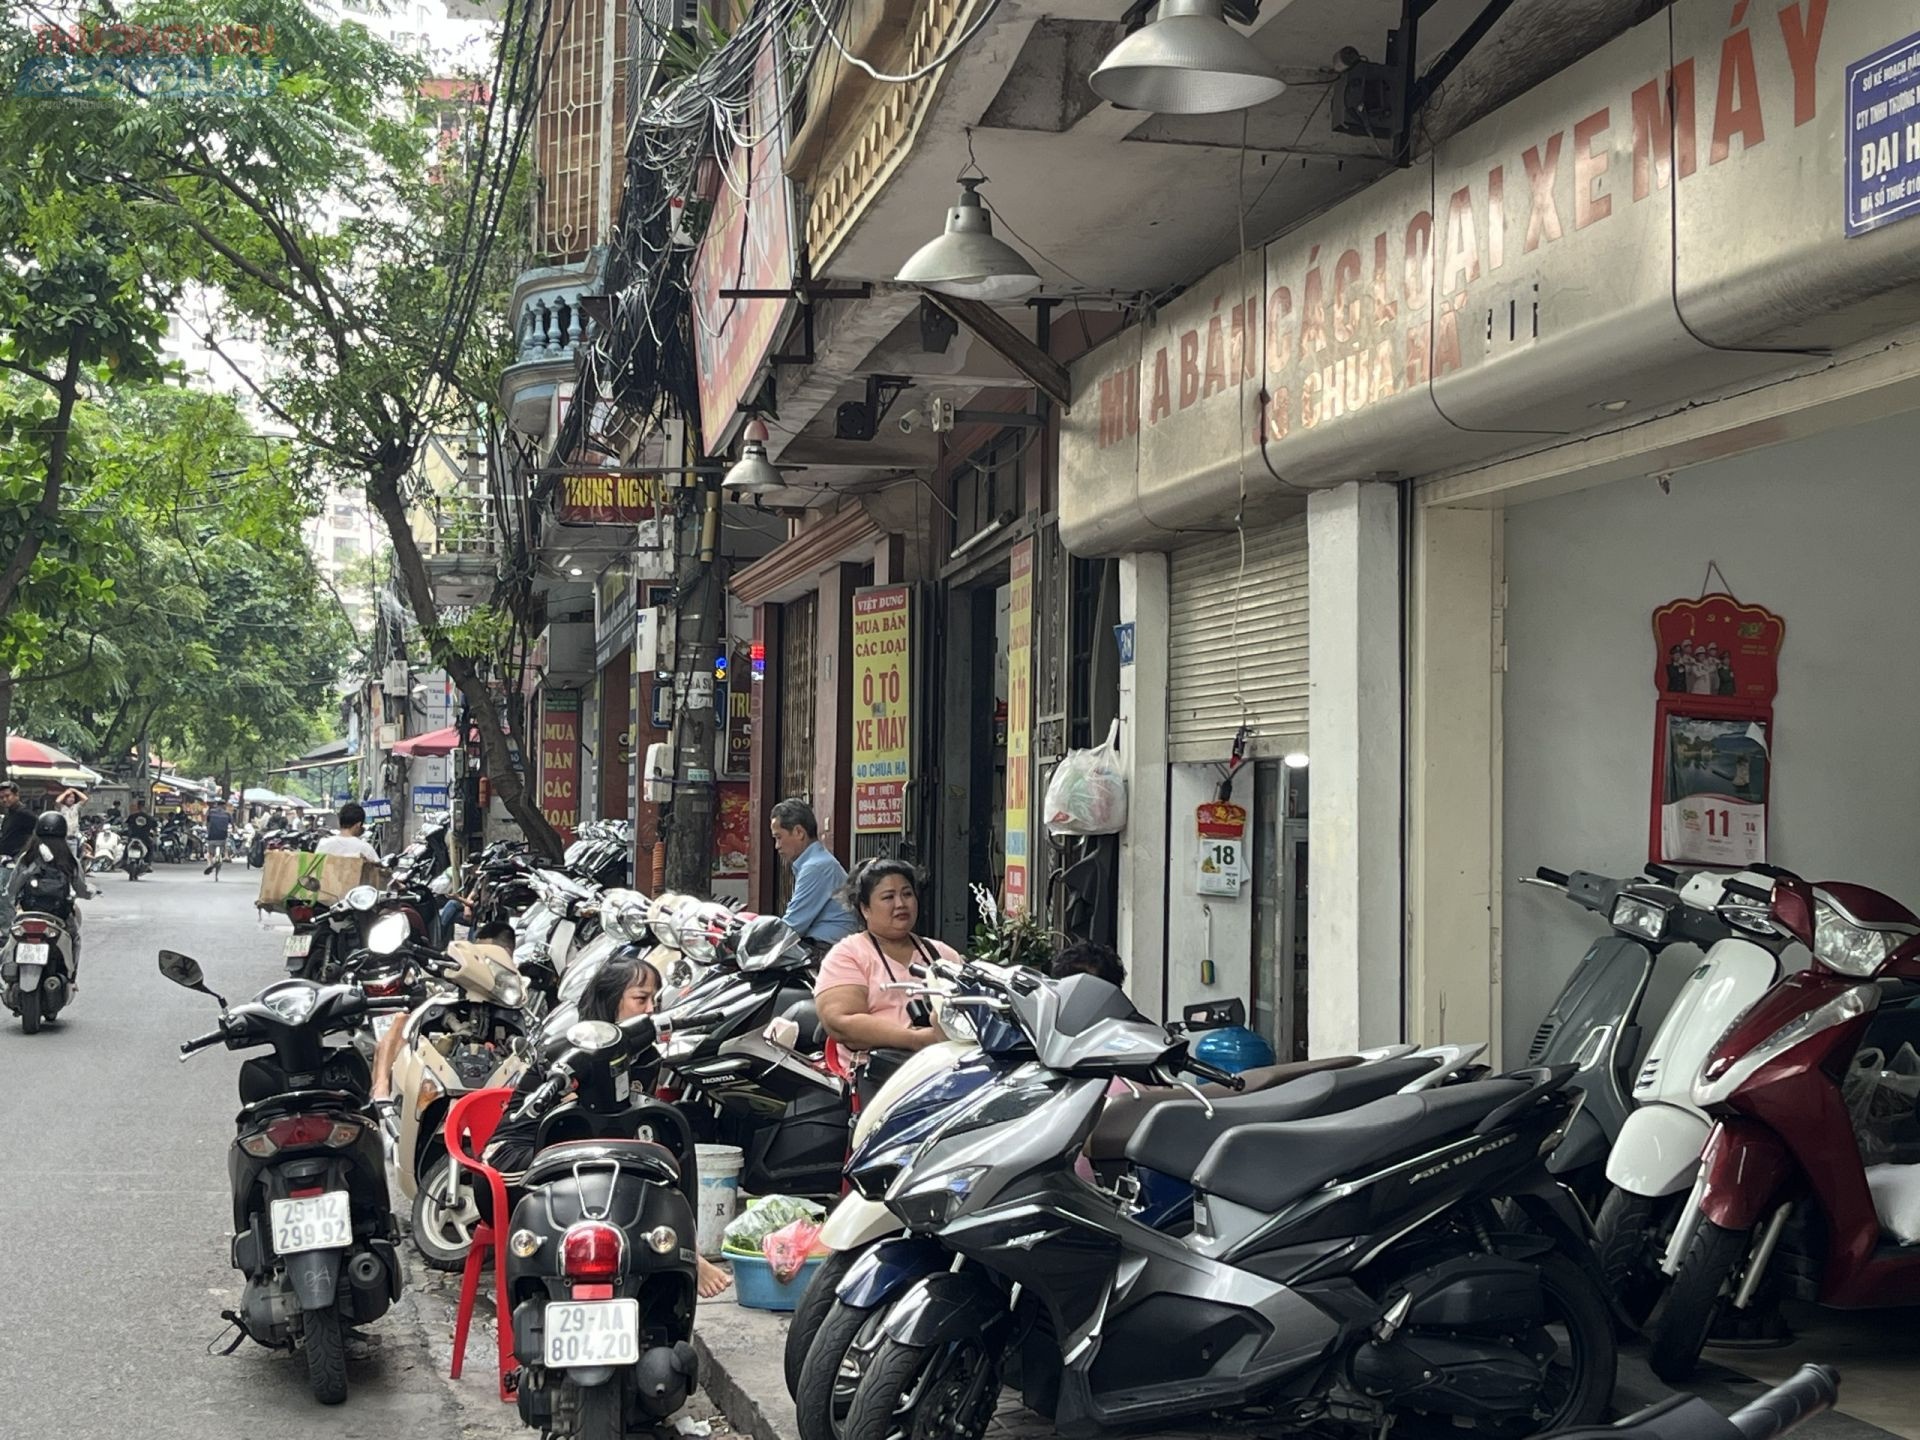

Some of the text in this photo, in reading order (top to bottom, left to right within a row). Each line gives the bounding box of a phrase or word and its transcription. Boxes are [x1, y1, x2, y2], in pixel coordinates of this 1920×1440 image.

[1856, 108, 1869, 131] CTY
[1860, 131, 1899, 183] ĐẠI
[1100, 346, 1171, 448] MUA
[1179, 295, 1256, 411] BÁN
[1267, 246, 1361, 373] CÁC
[1522, 107, 1612, 253] XE
[1631, 0, 1829, 203] MÁY
[563, 477, 613, 507] TRUNG
[855, 612, 906, 635] MUA BÁN
[855, 638, 906, 657] CÁC LOẠI
[863, 663, 900, 705] Ô TÔ
[545, 724, 576, 741] MUA
[856, 719, 873, 751] XE
[877, 709, 907, 750] MÁY
[545, 748, 573, 769] BÁN
[544, 776, 572, 798] CÁC
[544, 809, 576, 830] LOẠI
[1705, 809, 1729, 837] 11
[1212, 845, 1235, 865] 18
[702, 1074, 736, 1084] HONDA
[283, 1198, 338, 1225] 29-H2
[278, 1220, 347, 1250] 299.92
[559, 1305, 625, 1333] 29-AA
[551, 1332, 632, 1362] 804.20
